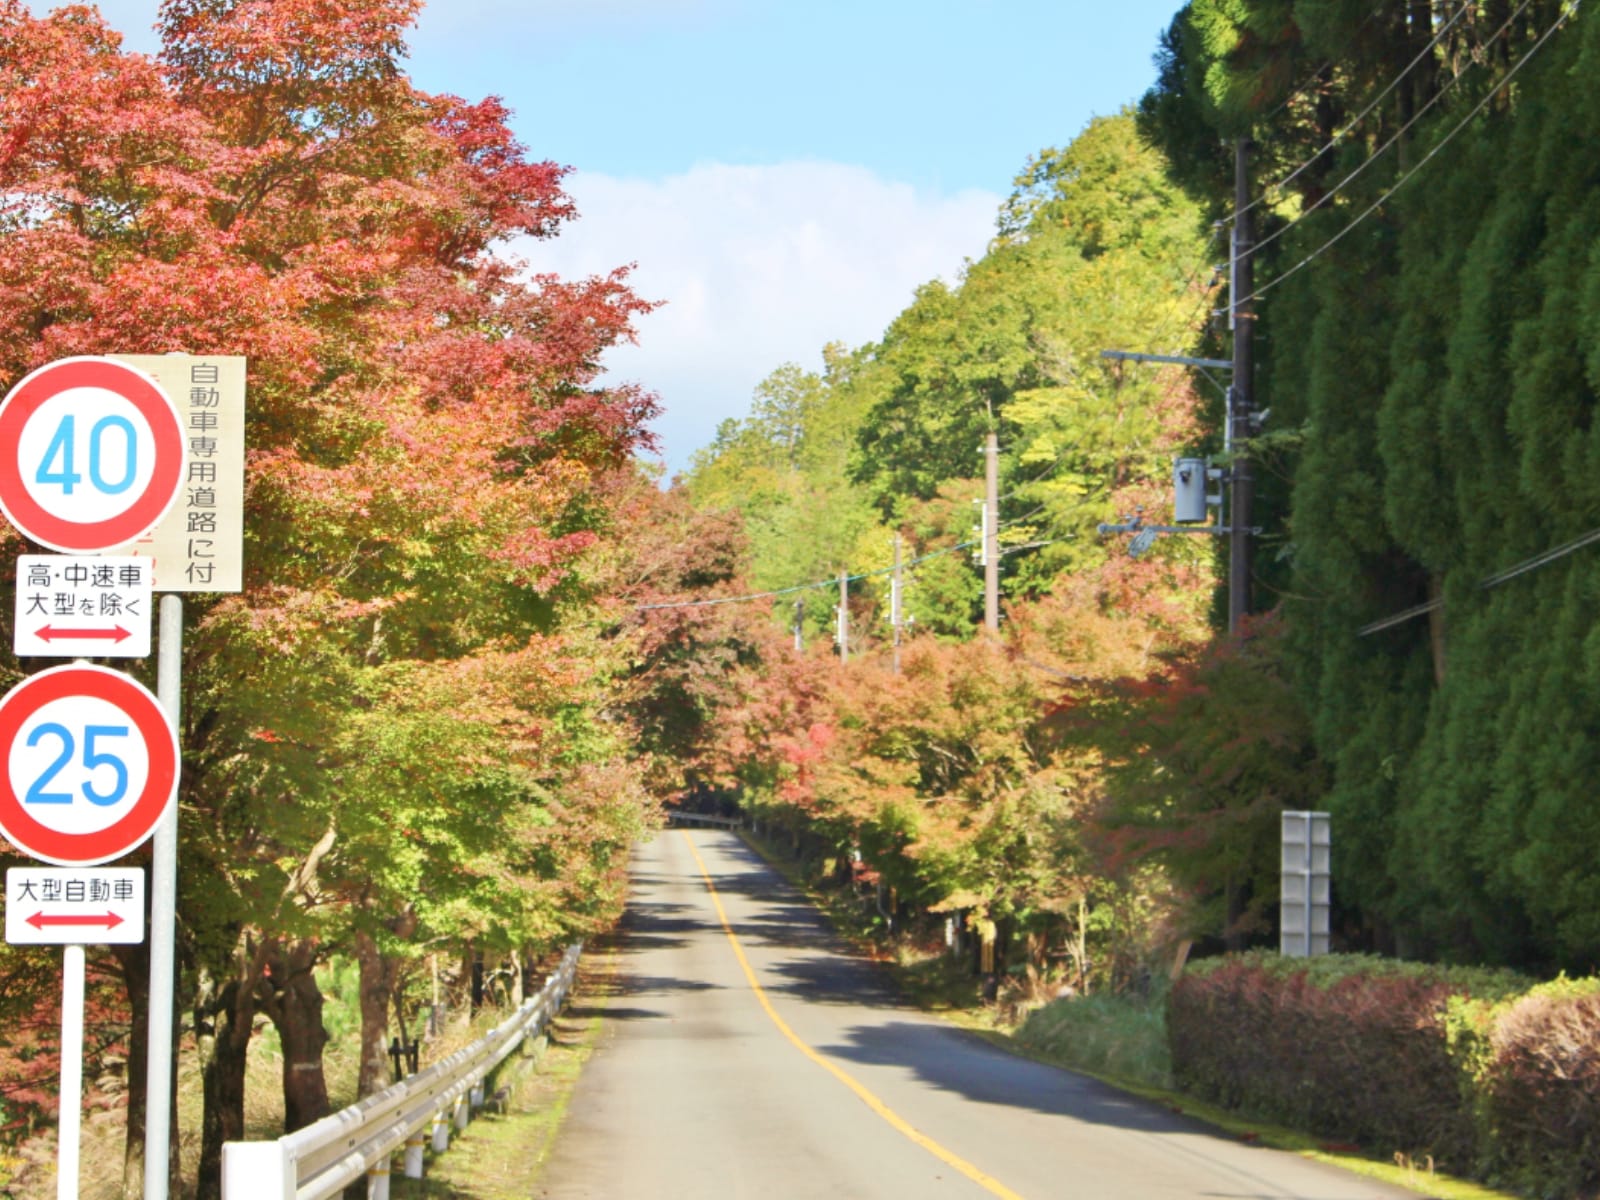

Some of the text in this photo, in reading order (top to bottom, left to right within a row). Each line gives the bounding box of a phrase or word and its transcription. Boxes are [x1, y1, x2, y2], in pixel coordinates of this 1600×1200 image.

[35, 414, 137, 495] 40
[185, 362, 219, 584] 自動車専用道路に付
[25, 592, 141, 616] 大型を除く
[25, 722, 129, 806] 25
[17, 878, 134, 902] 大型自動車
